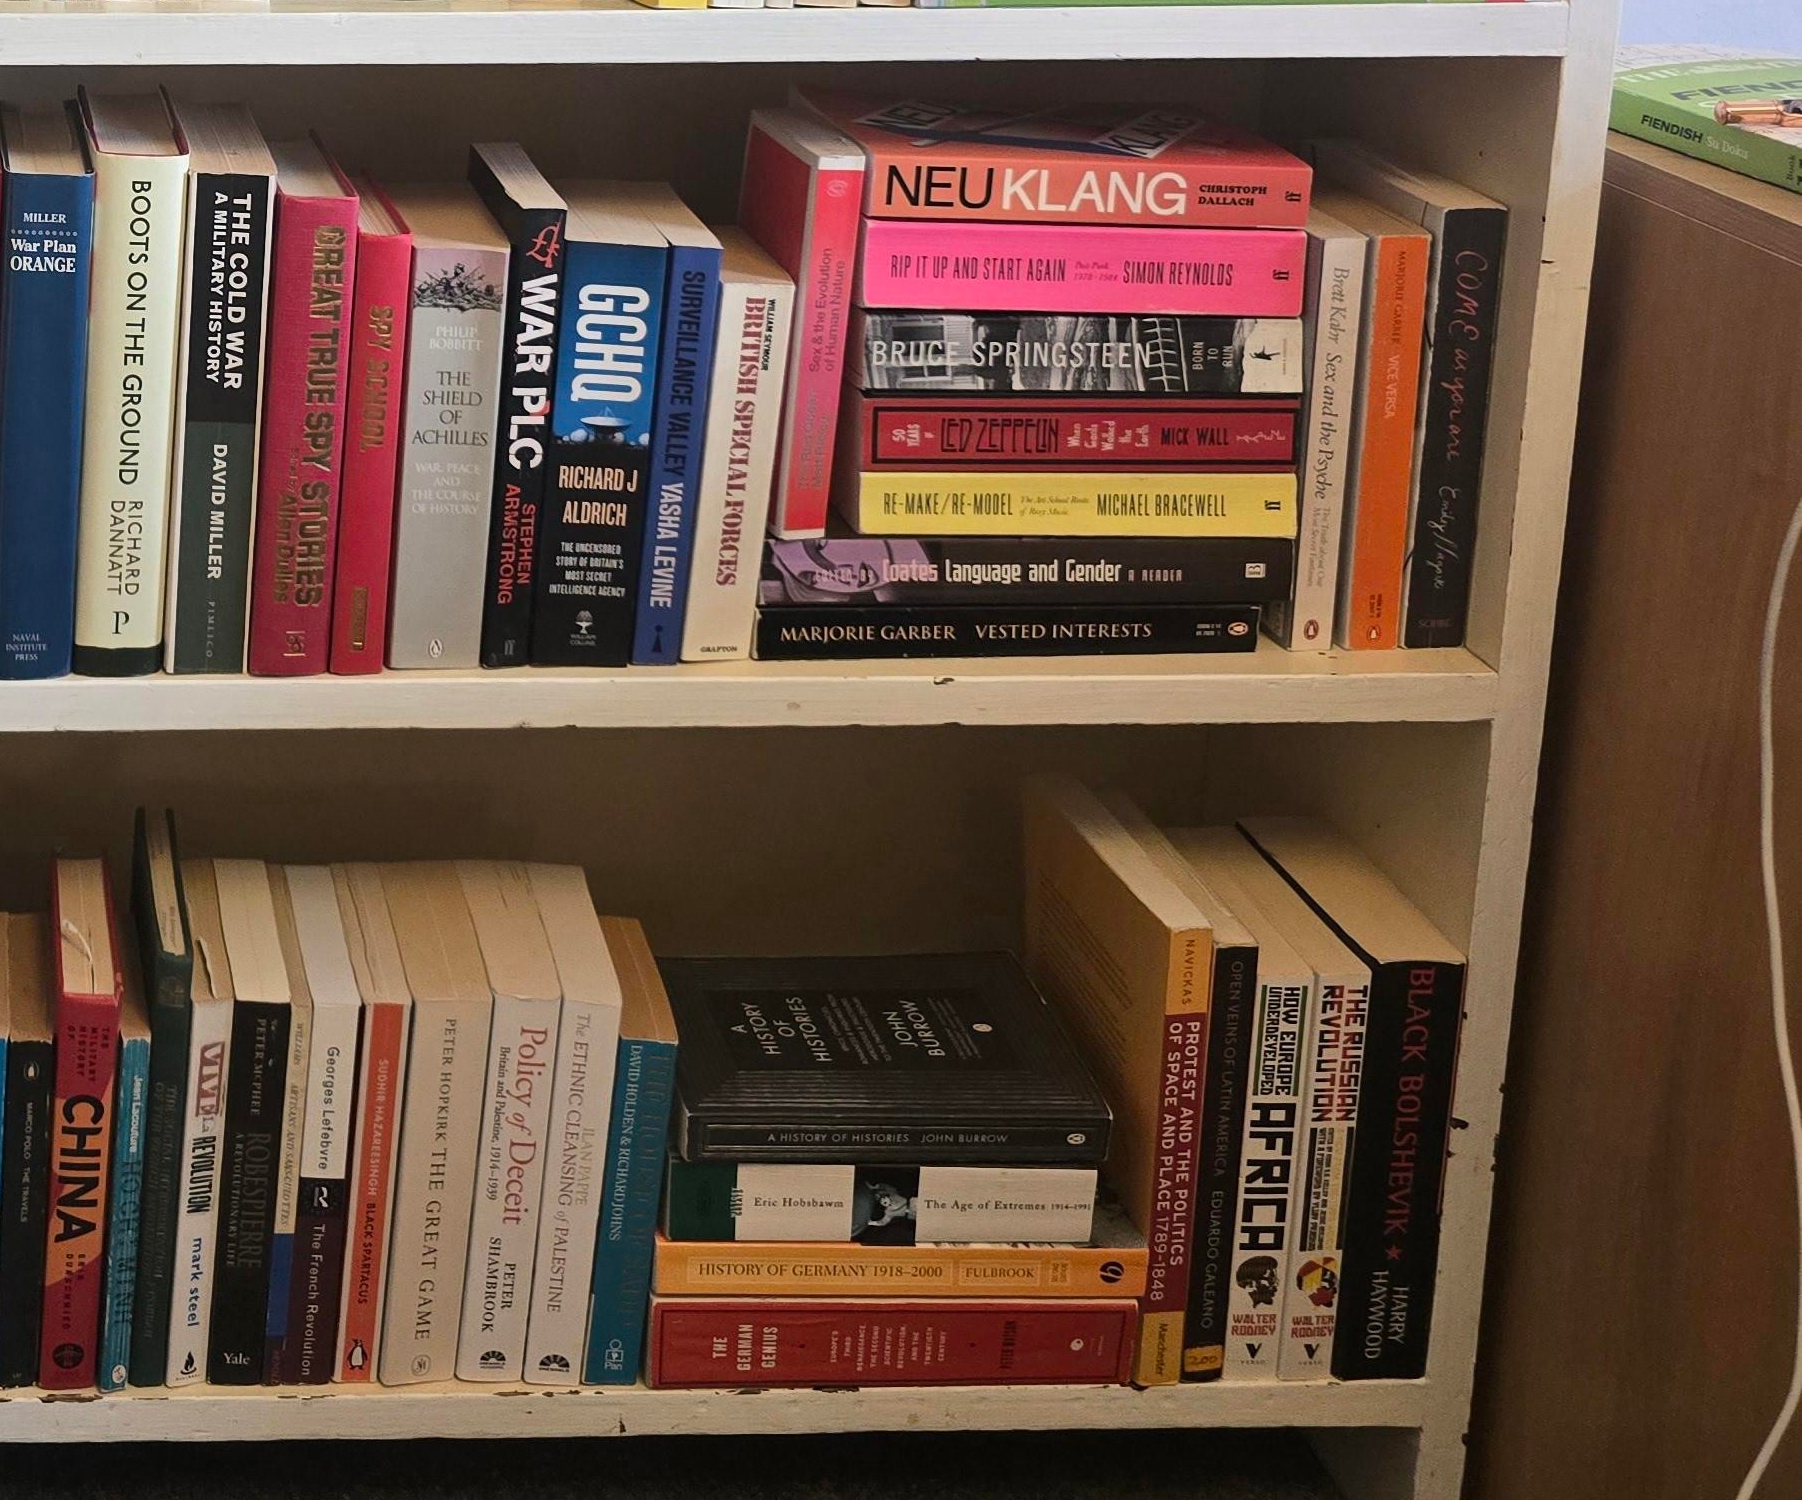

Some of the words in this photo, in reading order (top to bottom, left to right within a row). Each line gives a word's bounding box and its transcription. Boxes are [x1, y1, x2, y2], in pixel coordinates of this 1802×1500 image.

[1641, 115, 1703, 143] FIENDISH
[884, 165, 995, 210] NEU
[1002, 169, 1189, 216] KLANG
[1198, 183, 1267, 197] CHRISTOPH
[23, 212, 66, 223] MILLER
[11, 240, 40, 253] War
[44, 240, 77, 255] Plan
[10, 255, 76, 273] ORANGE
[890, 258, 913, 282] RIP
[917, 258, 930, 281] IT
[934, 258, 949, 281] UP
[953, 257, 977, 281] AND
[982, 257, 1021, 279] START
[1027, 257, 1066, 281] AGAIN
[1122, 259, 1160, 284] SIMON
[1167, 261, 1234, 286] REYNOLDS
[512, 274, 558, 376] WAR
[570, 284, 650, 402] GCHQ
[872, 339, 959, 368] BRUCE
[971, 338, 1150, 368] SPRINGSTEEN
[437, 372, 471, 386] THE
[423, 391, 483, 407] SHIELD
[439, 409, 463, 425] OF
[119, 374, 142, 487] GROUND
[412, 428, 488, 447] ACHILLES
[212, 444, 227, 503] DAVID
[559, 465, 624, 491] RICHARD
[563, 501, 627, 527] ALDRICH
[1096, 492, 1148, 518] MICHAEL
[1153, 494, 1227, 516] BRACEWELL
[208, 511, 225, 579] MILLER
[779, 625, 876, 644] MARJORIE
[880, 622, 956, 640] GARBER
[975, 622, 1046, 640] VESTED
[1049, 621, 1152, 639] INTERESTS
[1398, 966, 1436, 1063] BLACK
[514, 1025, 548, 1110] Policy
[512, 1112, 532, 1137] of
[780, 1133, 827, 1143] HISTORY
[832, 1133, 846, 1142] OF
[852, 1133, 909, 1143] HISTORIES
[921, 1133, 953, 1143] JOHN
[958, 1133, 1008, 1143] BURROW
[1383, 1075, 1422, 1233] BOLSHEVIK
[54, 1093, 105, 1244] CHINA
[1240, 1102, 1296, 1250] AFRICA
[503, 1139, 538, 1226] Deceit
[754, 1196, 777, 1207] Eric
[782, 1197, 844, 1209] Hobsbawm
[698, 1263, 762, 1276] HISTORY
[767, 1263, 788, 1277] OF
[792, 1264, 867, 1277] GERMANY
[966, 1267, 1035, 1278] FULBROOK
[223, 1353, 250, 1366] Yale
[737, 1325, 753, 1370] GERMAN
